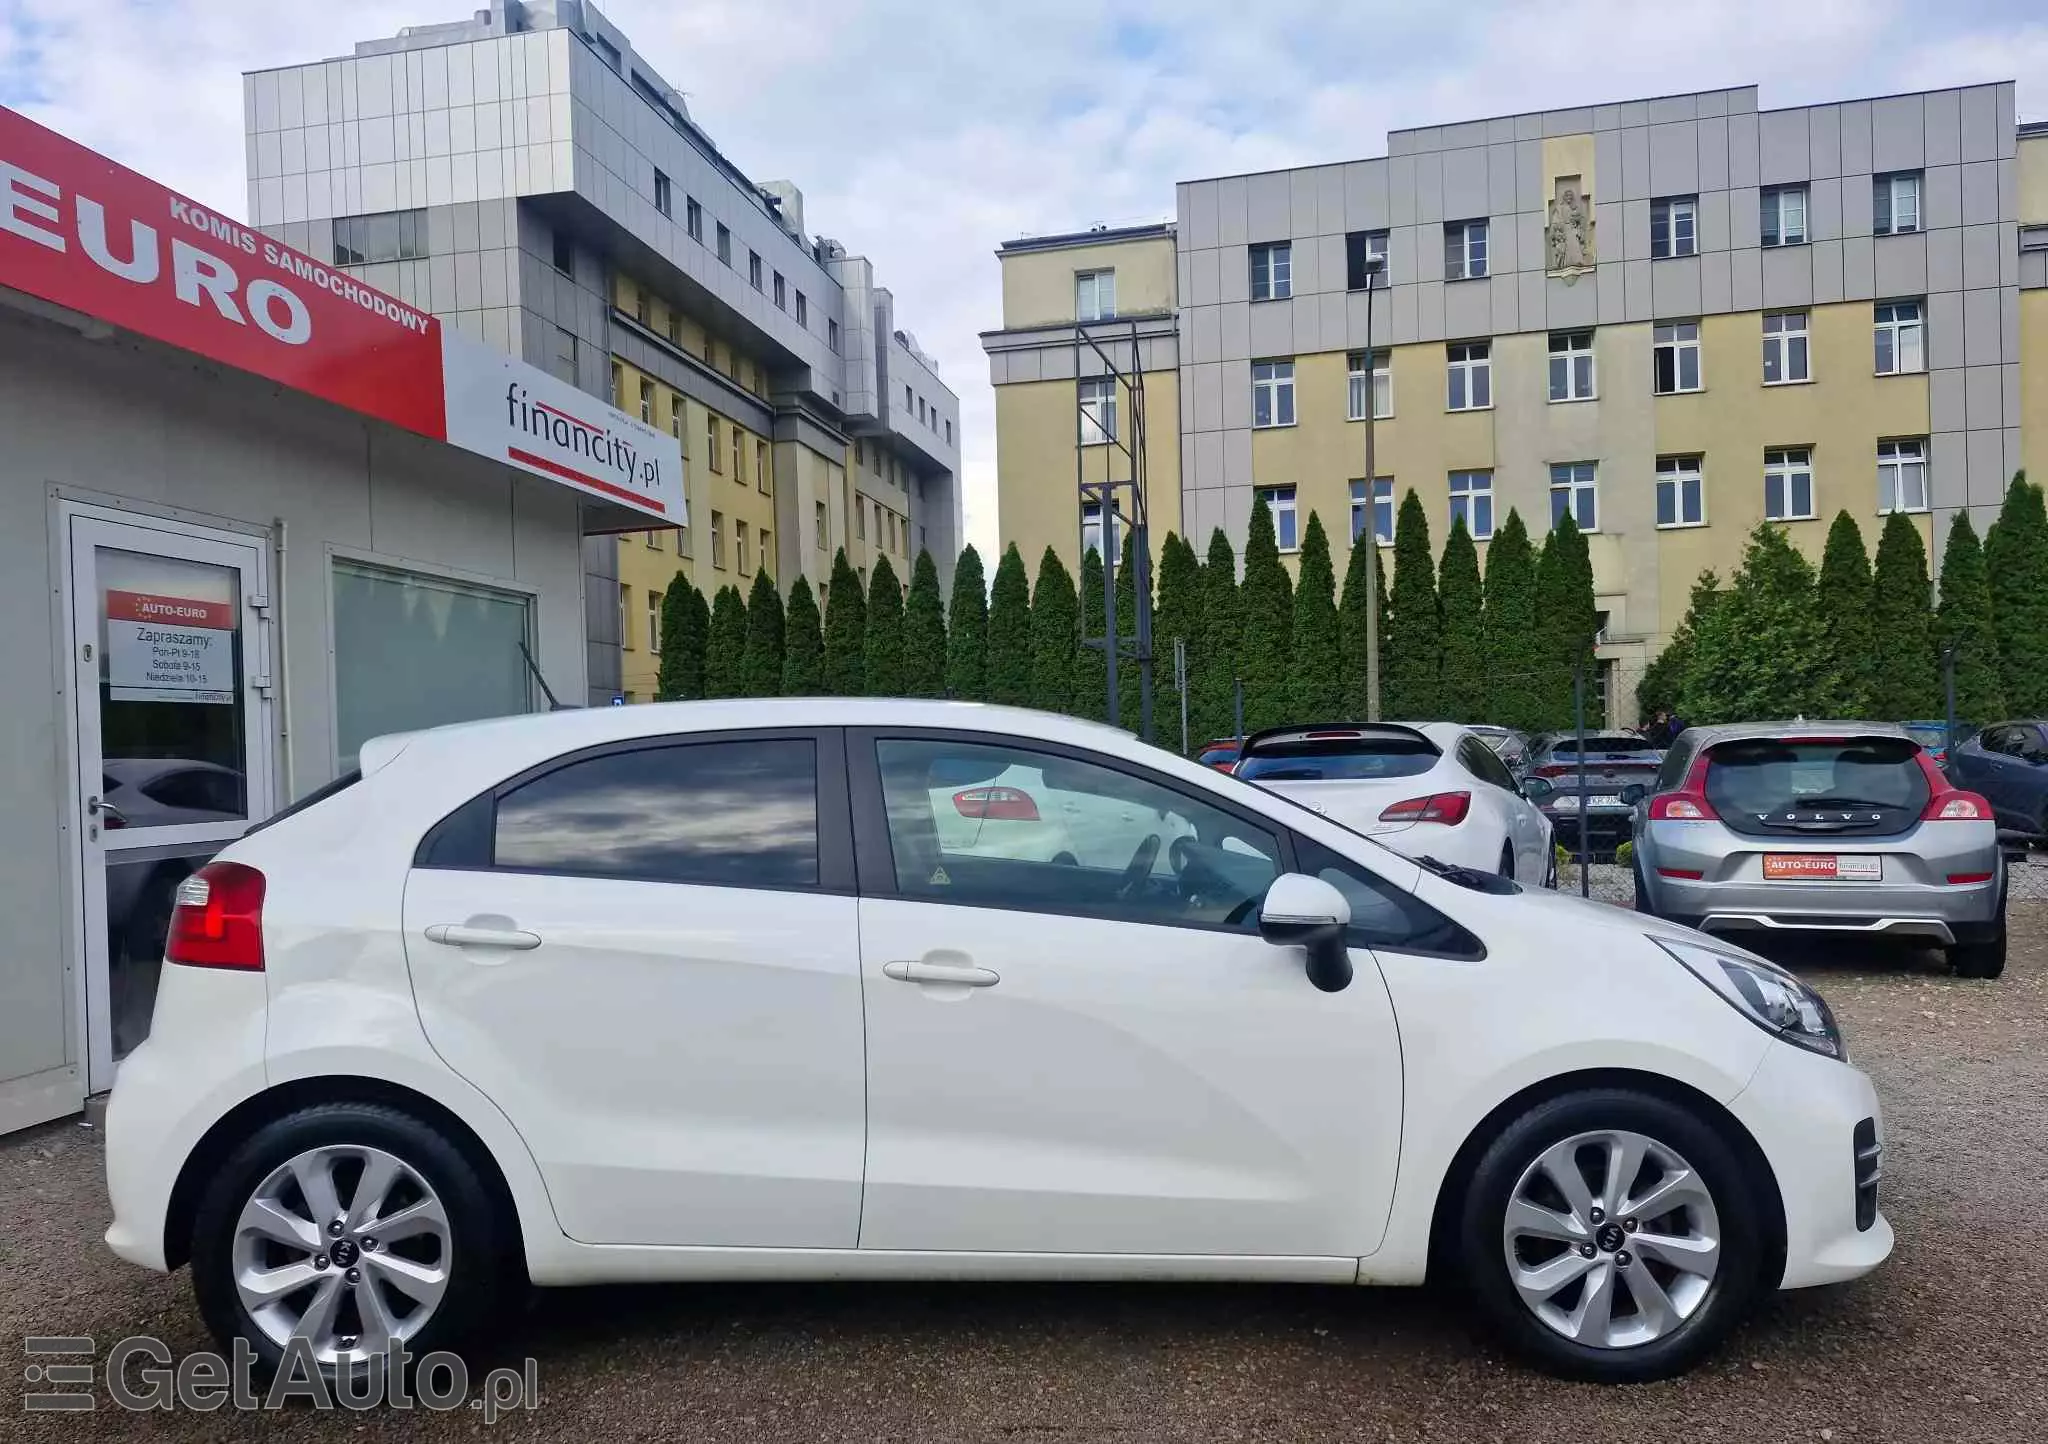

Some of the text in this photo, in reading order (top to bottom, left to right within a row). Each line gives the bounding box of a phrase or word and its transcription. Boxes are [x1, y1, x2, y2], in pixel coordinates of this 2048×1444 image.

[169, 196, 429, 335] KOMIS SAMOCHODOWY
[506, 382, 661, 489] financity.pl
[142, 603, 207, 618] AUTO-EURO
[136, 627, 214, 649] Zapraszamy:
[1771, 861, 1836, 870] AUTO-EURO
